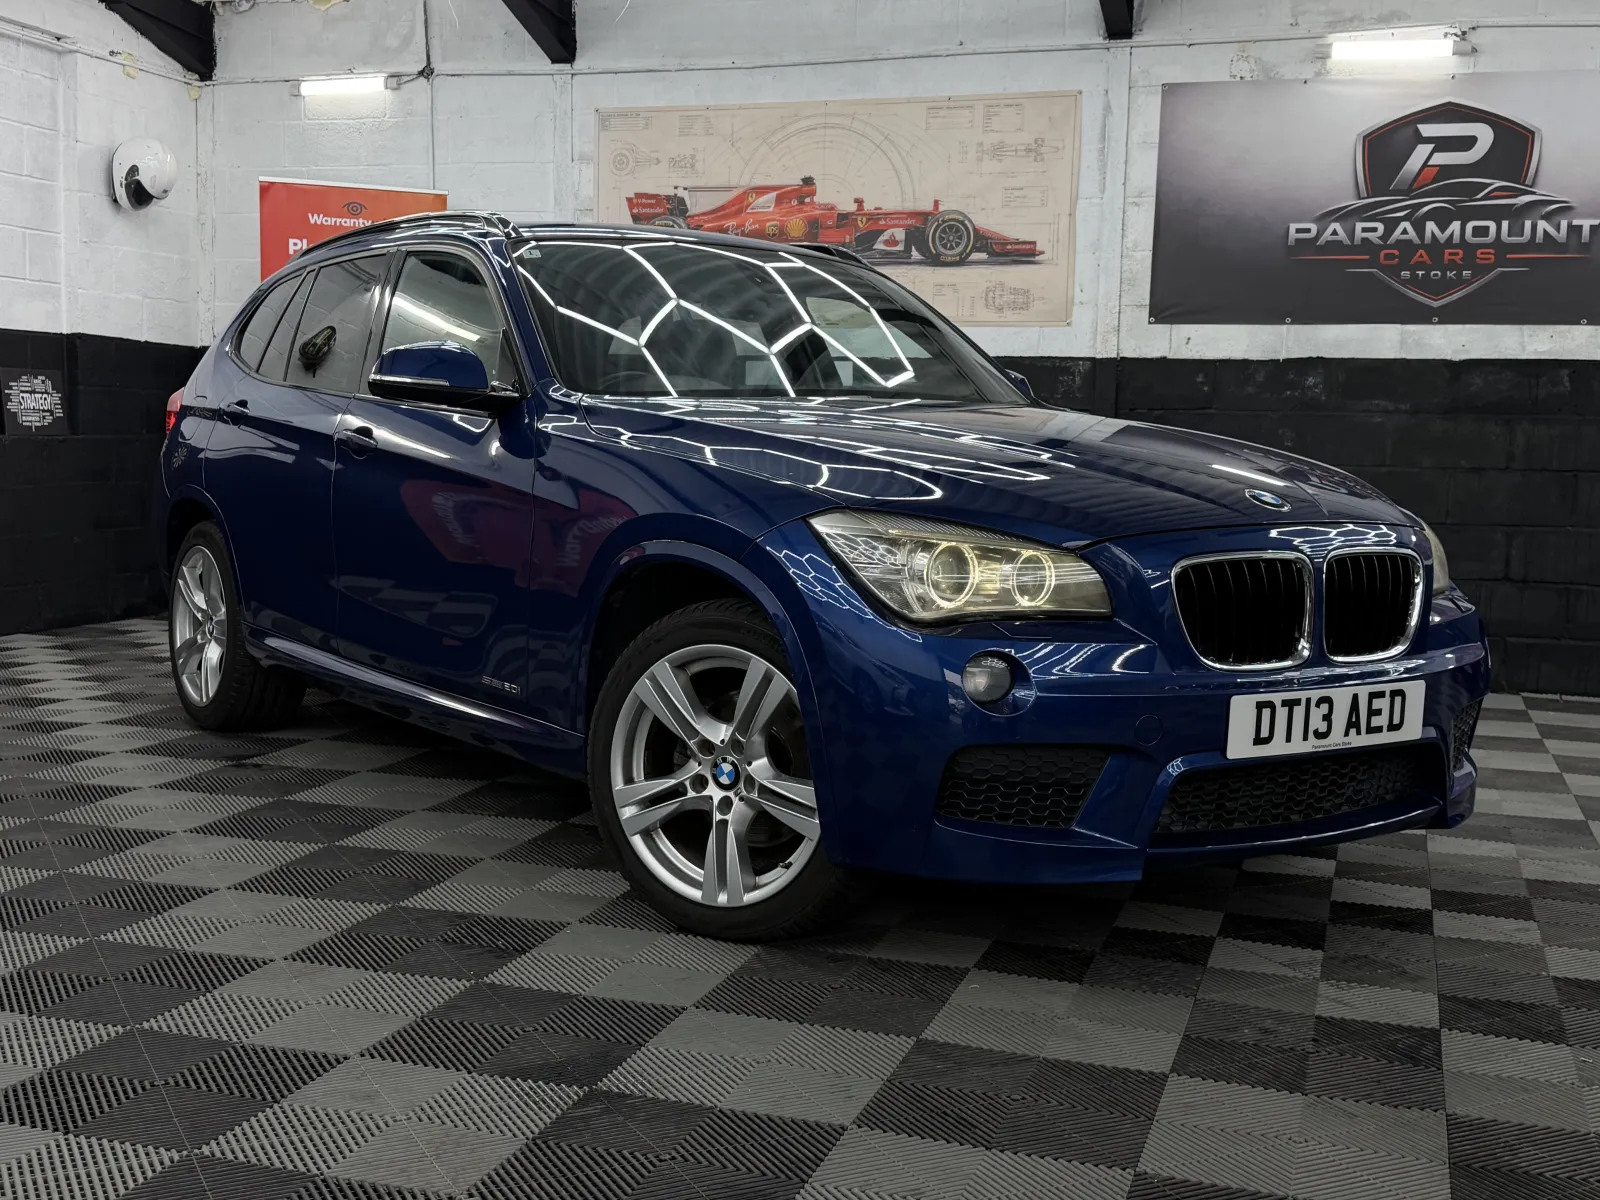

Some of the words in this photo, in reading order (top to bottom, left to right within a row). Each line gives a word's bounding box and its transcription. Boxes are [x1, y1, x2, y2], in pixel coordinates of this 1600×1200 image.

[885, 217, 916, 226] Santander
[1287, 219, 1600, 247] PARAMOUNT
[1011, 242, 1036, 250] Santander
[1379, 248, 1496, 265] CARS
[1400, 269, 1473, 280] STOKE
[20, 393, 51, 410] STRATEGY
[1252, 695, 1334, 746] DT13
[1343, 688, 1407, 738] AED
